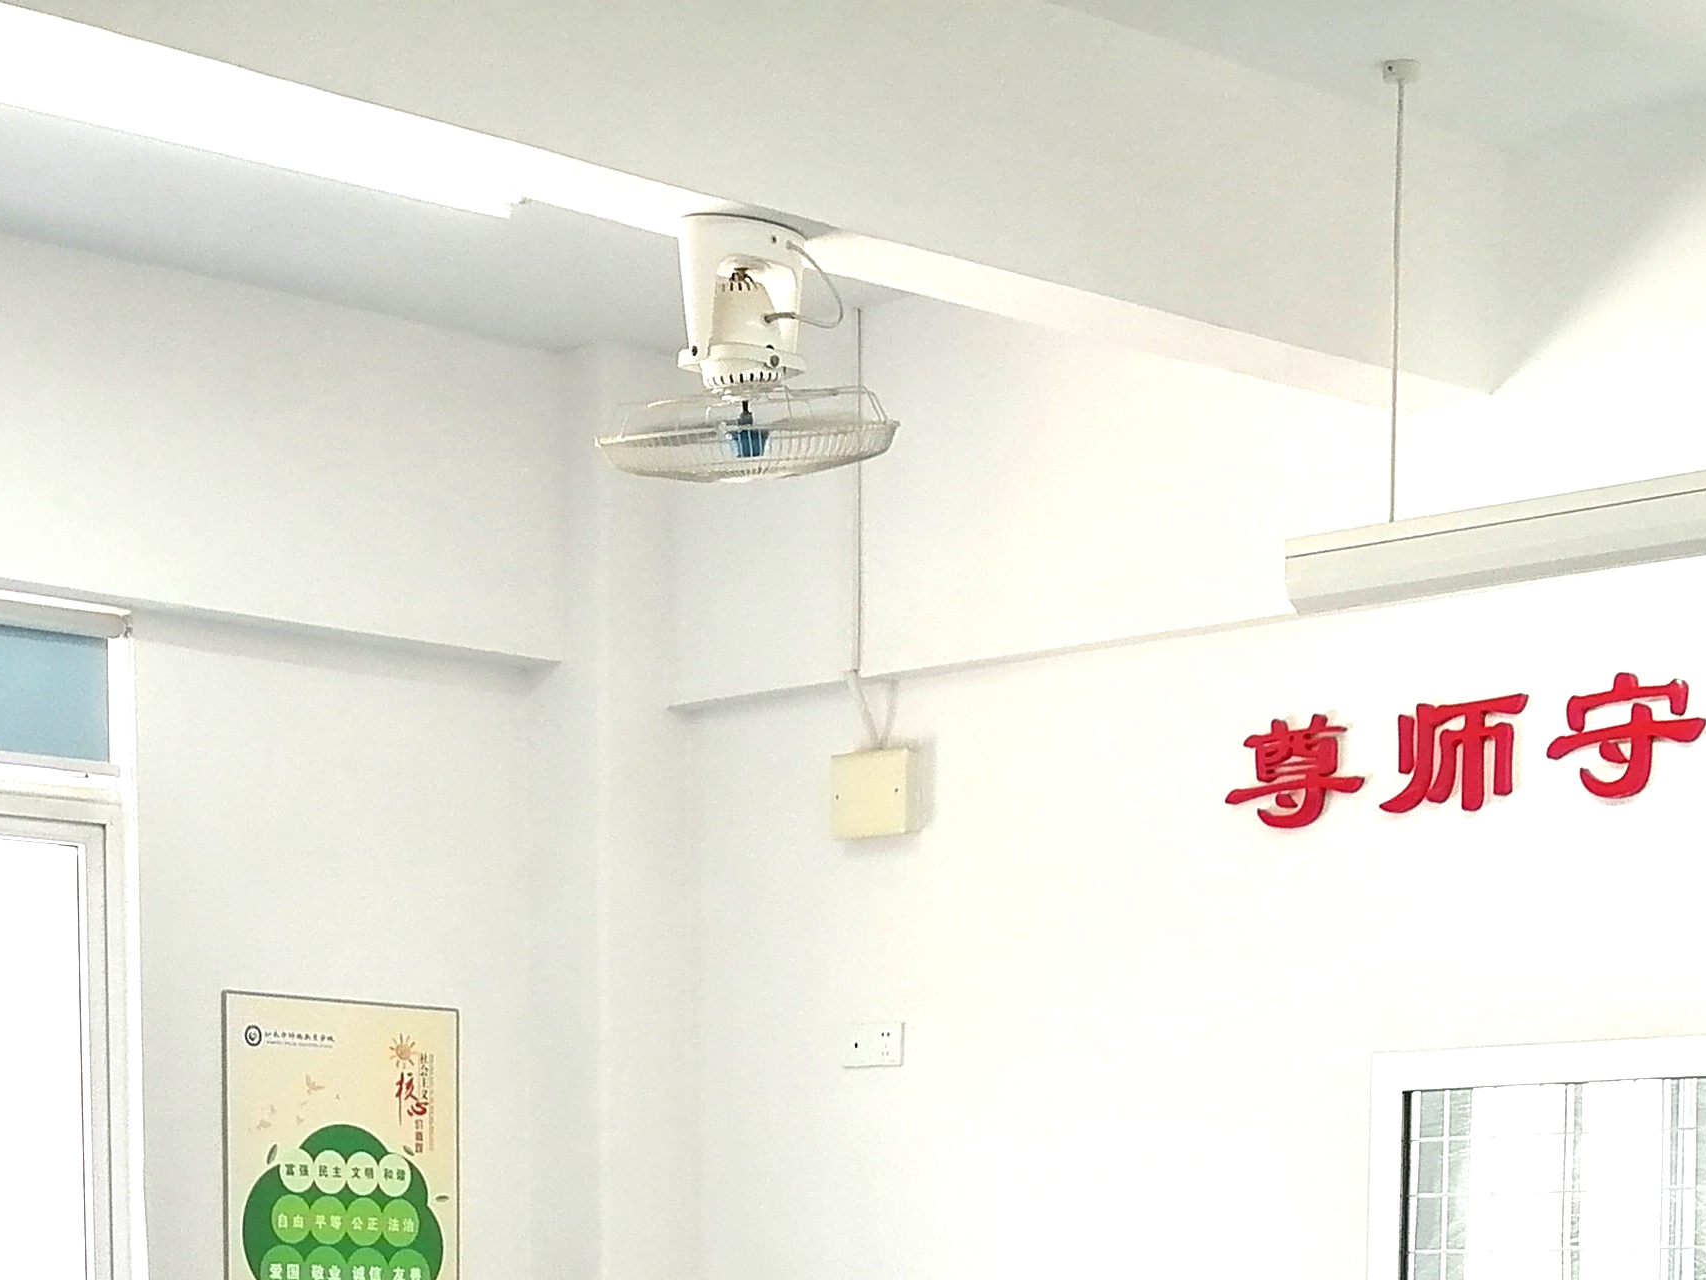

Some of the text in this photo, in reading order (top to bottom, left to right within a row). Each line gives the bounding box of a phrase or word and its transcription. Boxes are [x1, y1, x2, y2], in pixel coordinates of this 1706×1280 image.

[285, 1163, 406, 1181] 富强 民主 文明 和谐
[277, 1213, 415, 1232] 自由 平等 公正 法治
[269, 1263, 300, 1280] 爱国
[311, 1264, 342, 1280] 敬业
